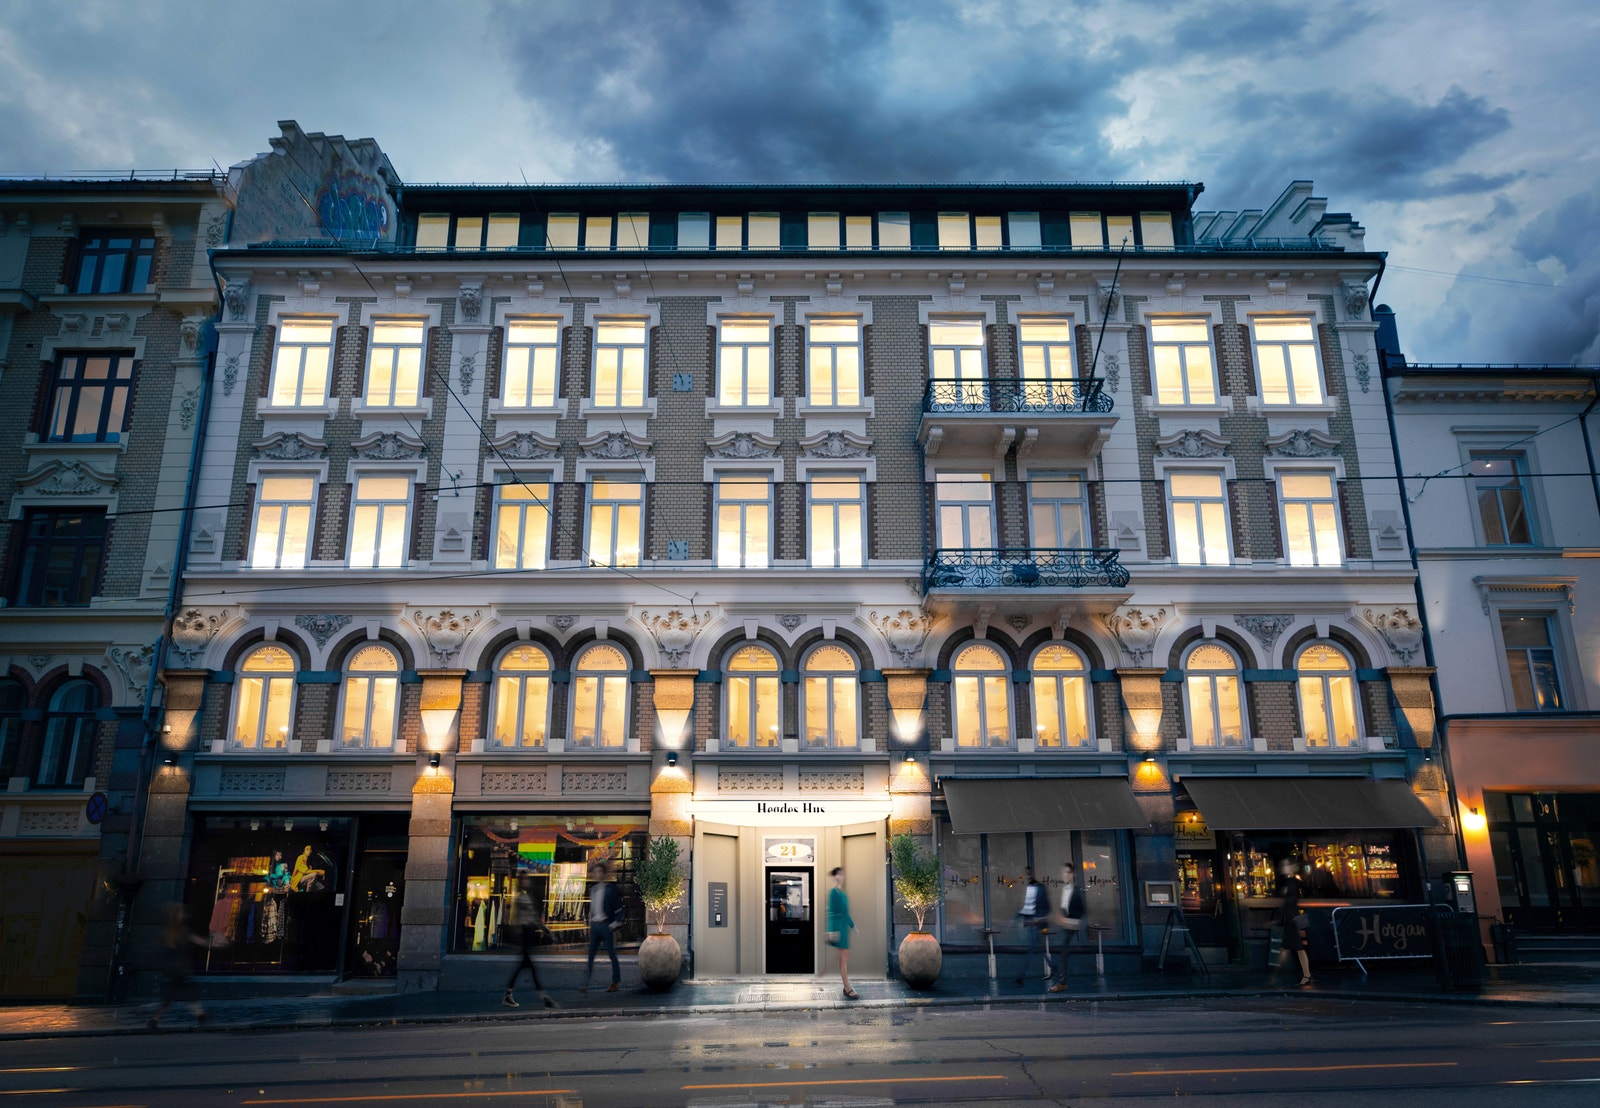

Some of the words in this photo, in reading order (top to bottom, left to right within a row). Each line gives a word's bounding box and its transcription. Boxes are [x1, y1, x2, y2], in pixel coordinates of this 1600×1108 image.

[958, 645, 1002, 665] TANNREGULERING
[1190, 644, 1233, 665] TANNREGULERING
[780, 845, 797, 856] 24
